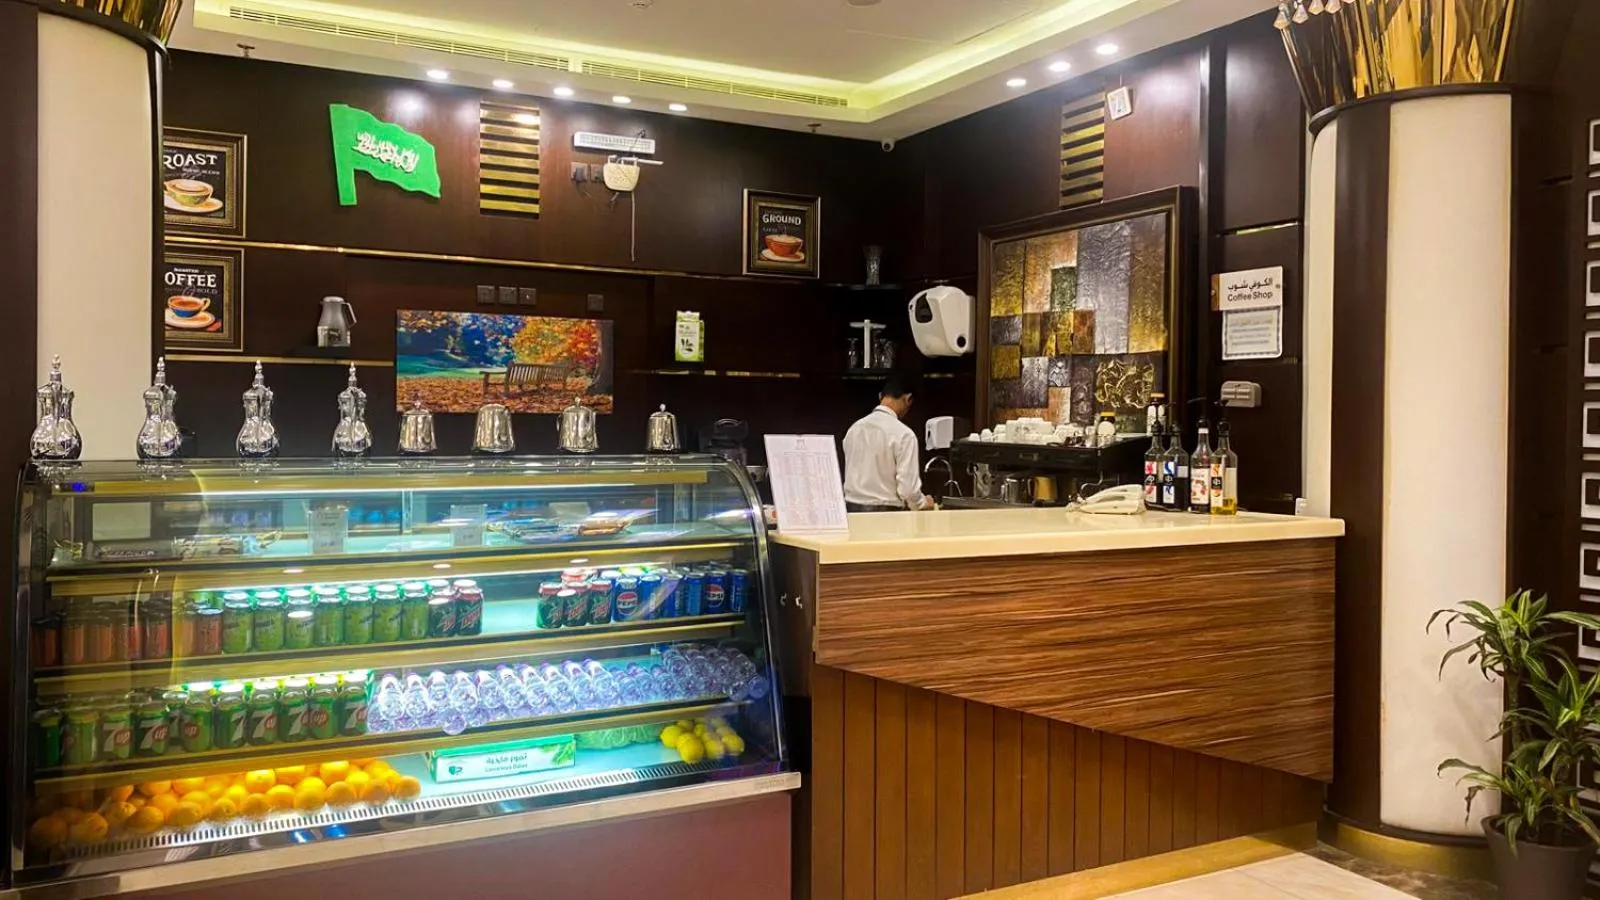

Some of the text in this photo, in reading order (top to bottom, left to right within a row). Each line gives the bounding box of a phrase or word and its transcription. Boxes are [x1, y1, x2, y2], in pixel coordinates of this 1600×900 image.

[163, 153, 218, 170] ROAST
[762, 213, 802, 225] GROUND
[164, 271, 217, 288] OFFEE
[1227, 291, 1273, 301] Coffee Shop
